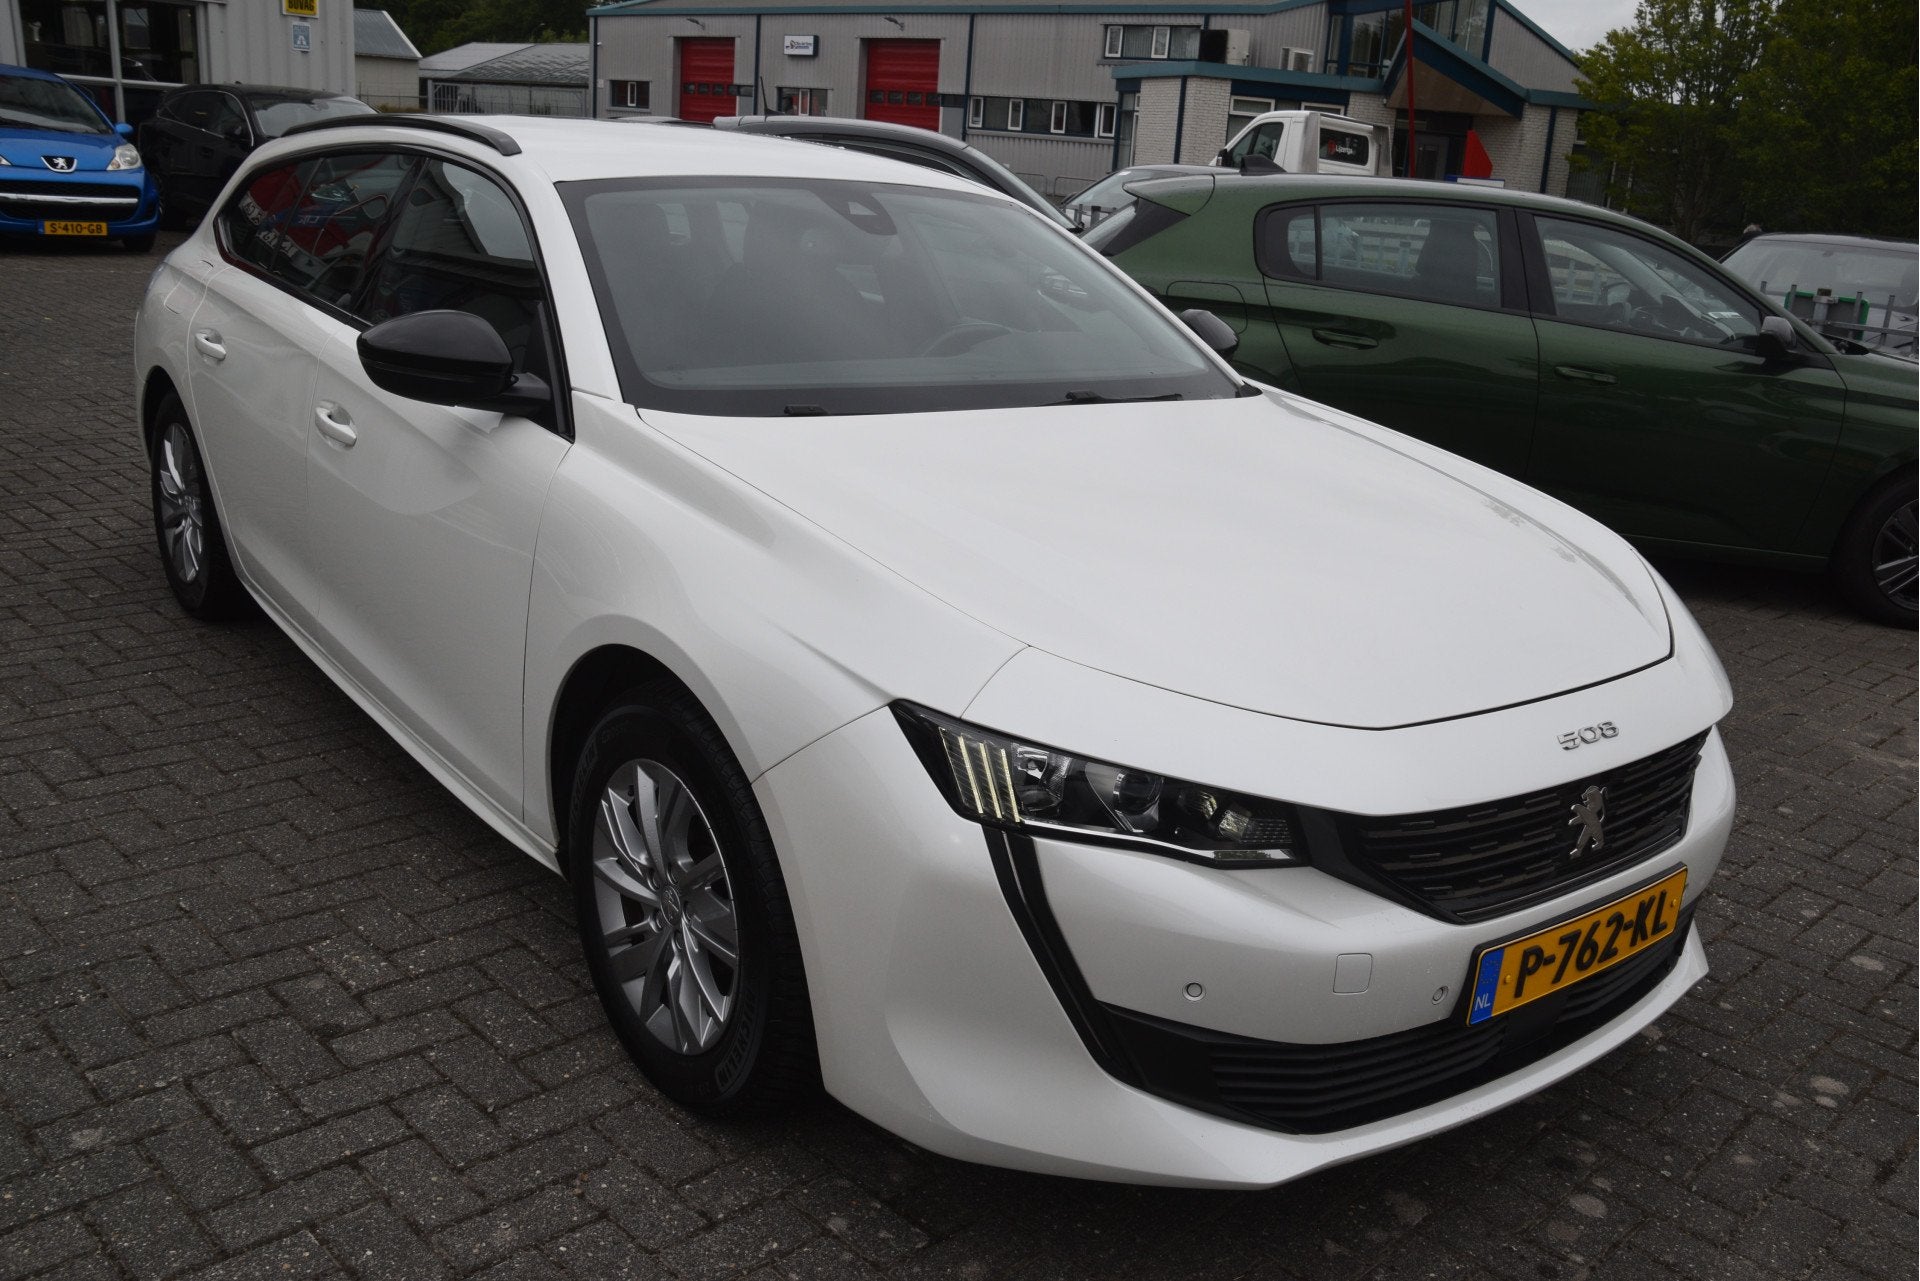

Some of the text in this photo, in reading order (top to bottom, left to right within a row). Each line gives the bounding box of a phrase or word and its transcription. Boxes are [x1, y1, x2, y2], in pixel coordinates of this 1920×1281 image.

[288, 0, 314, 11] BOVAG
[50, 222, 103, 234] S-410-GB
[1557, 721, 1619, 751] 508
[1514, 889, 1667, 998] P-762-KL
[1474, 992, 1491, 1011] NL
